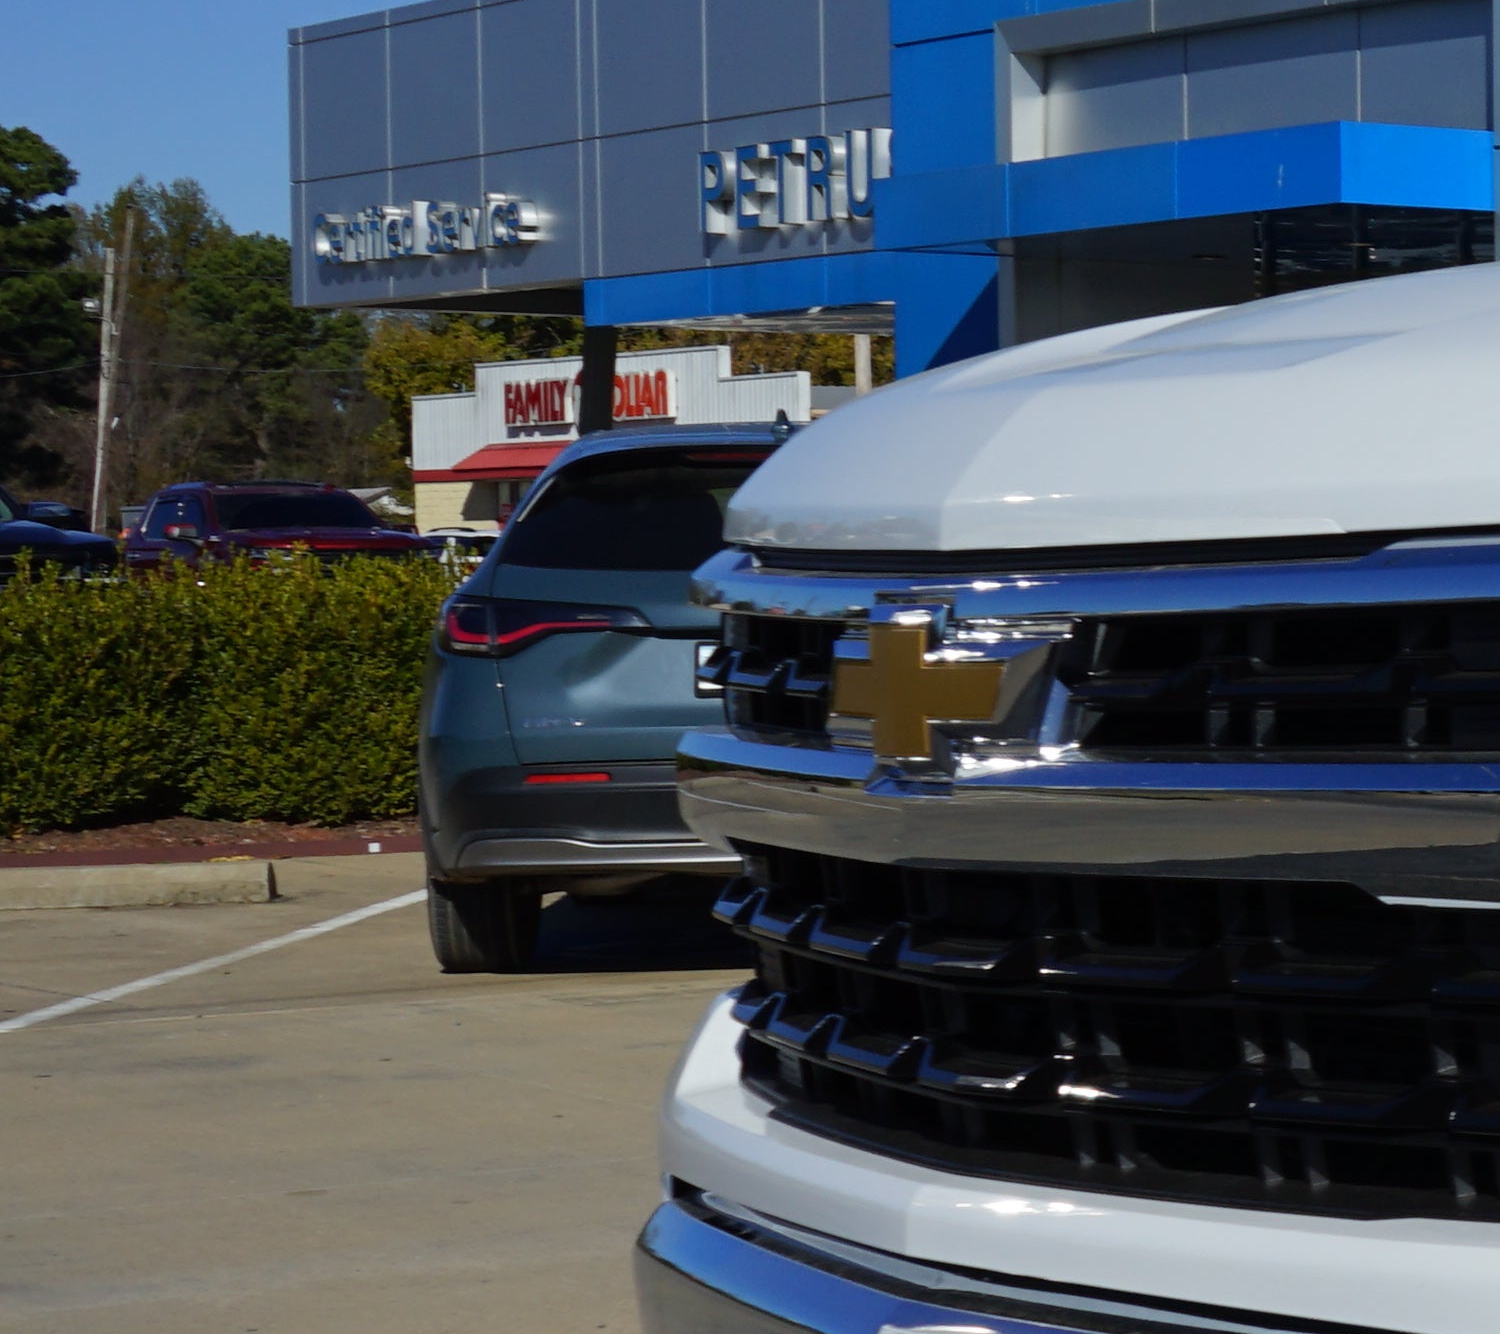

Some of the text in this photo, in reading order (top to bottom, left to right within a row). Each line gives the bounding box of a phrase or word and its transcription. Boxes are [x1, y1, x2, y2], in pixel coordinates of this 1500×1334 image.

[698, 127, 893, 235] PETRU
[313, 192, 541, 265] Certified Service
[503, 369, 670, 425] FAMILY OLLAR
